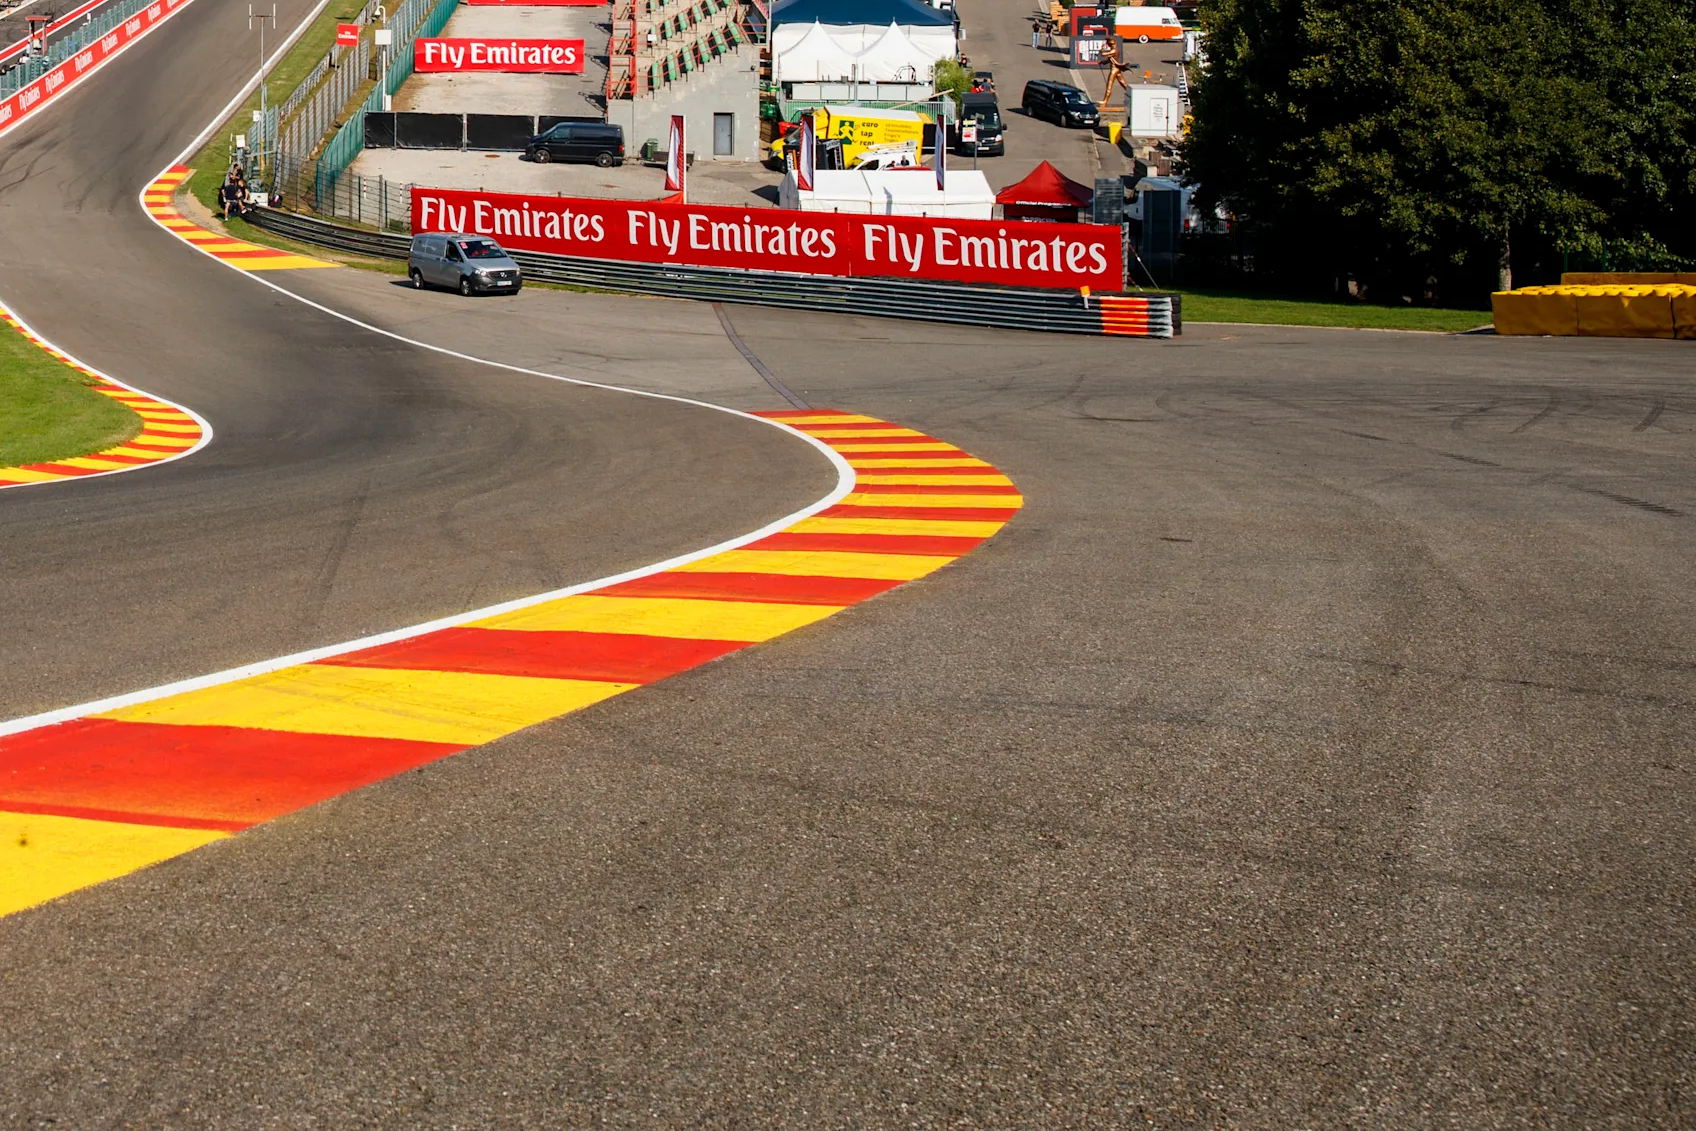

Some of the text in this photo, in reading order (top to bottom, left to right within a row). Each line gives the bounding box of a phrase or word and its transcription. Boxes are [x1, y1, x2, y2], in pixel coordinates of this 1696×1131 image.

[424, 42, 576, 68] Fly Emirates
[421, 197, 604, 242] Fly Emirates
[627, 210, 836, 258] Fly Emirates
[863, 224, 1107, 274] Fly Emirates
